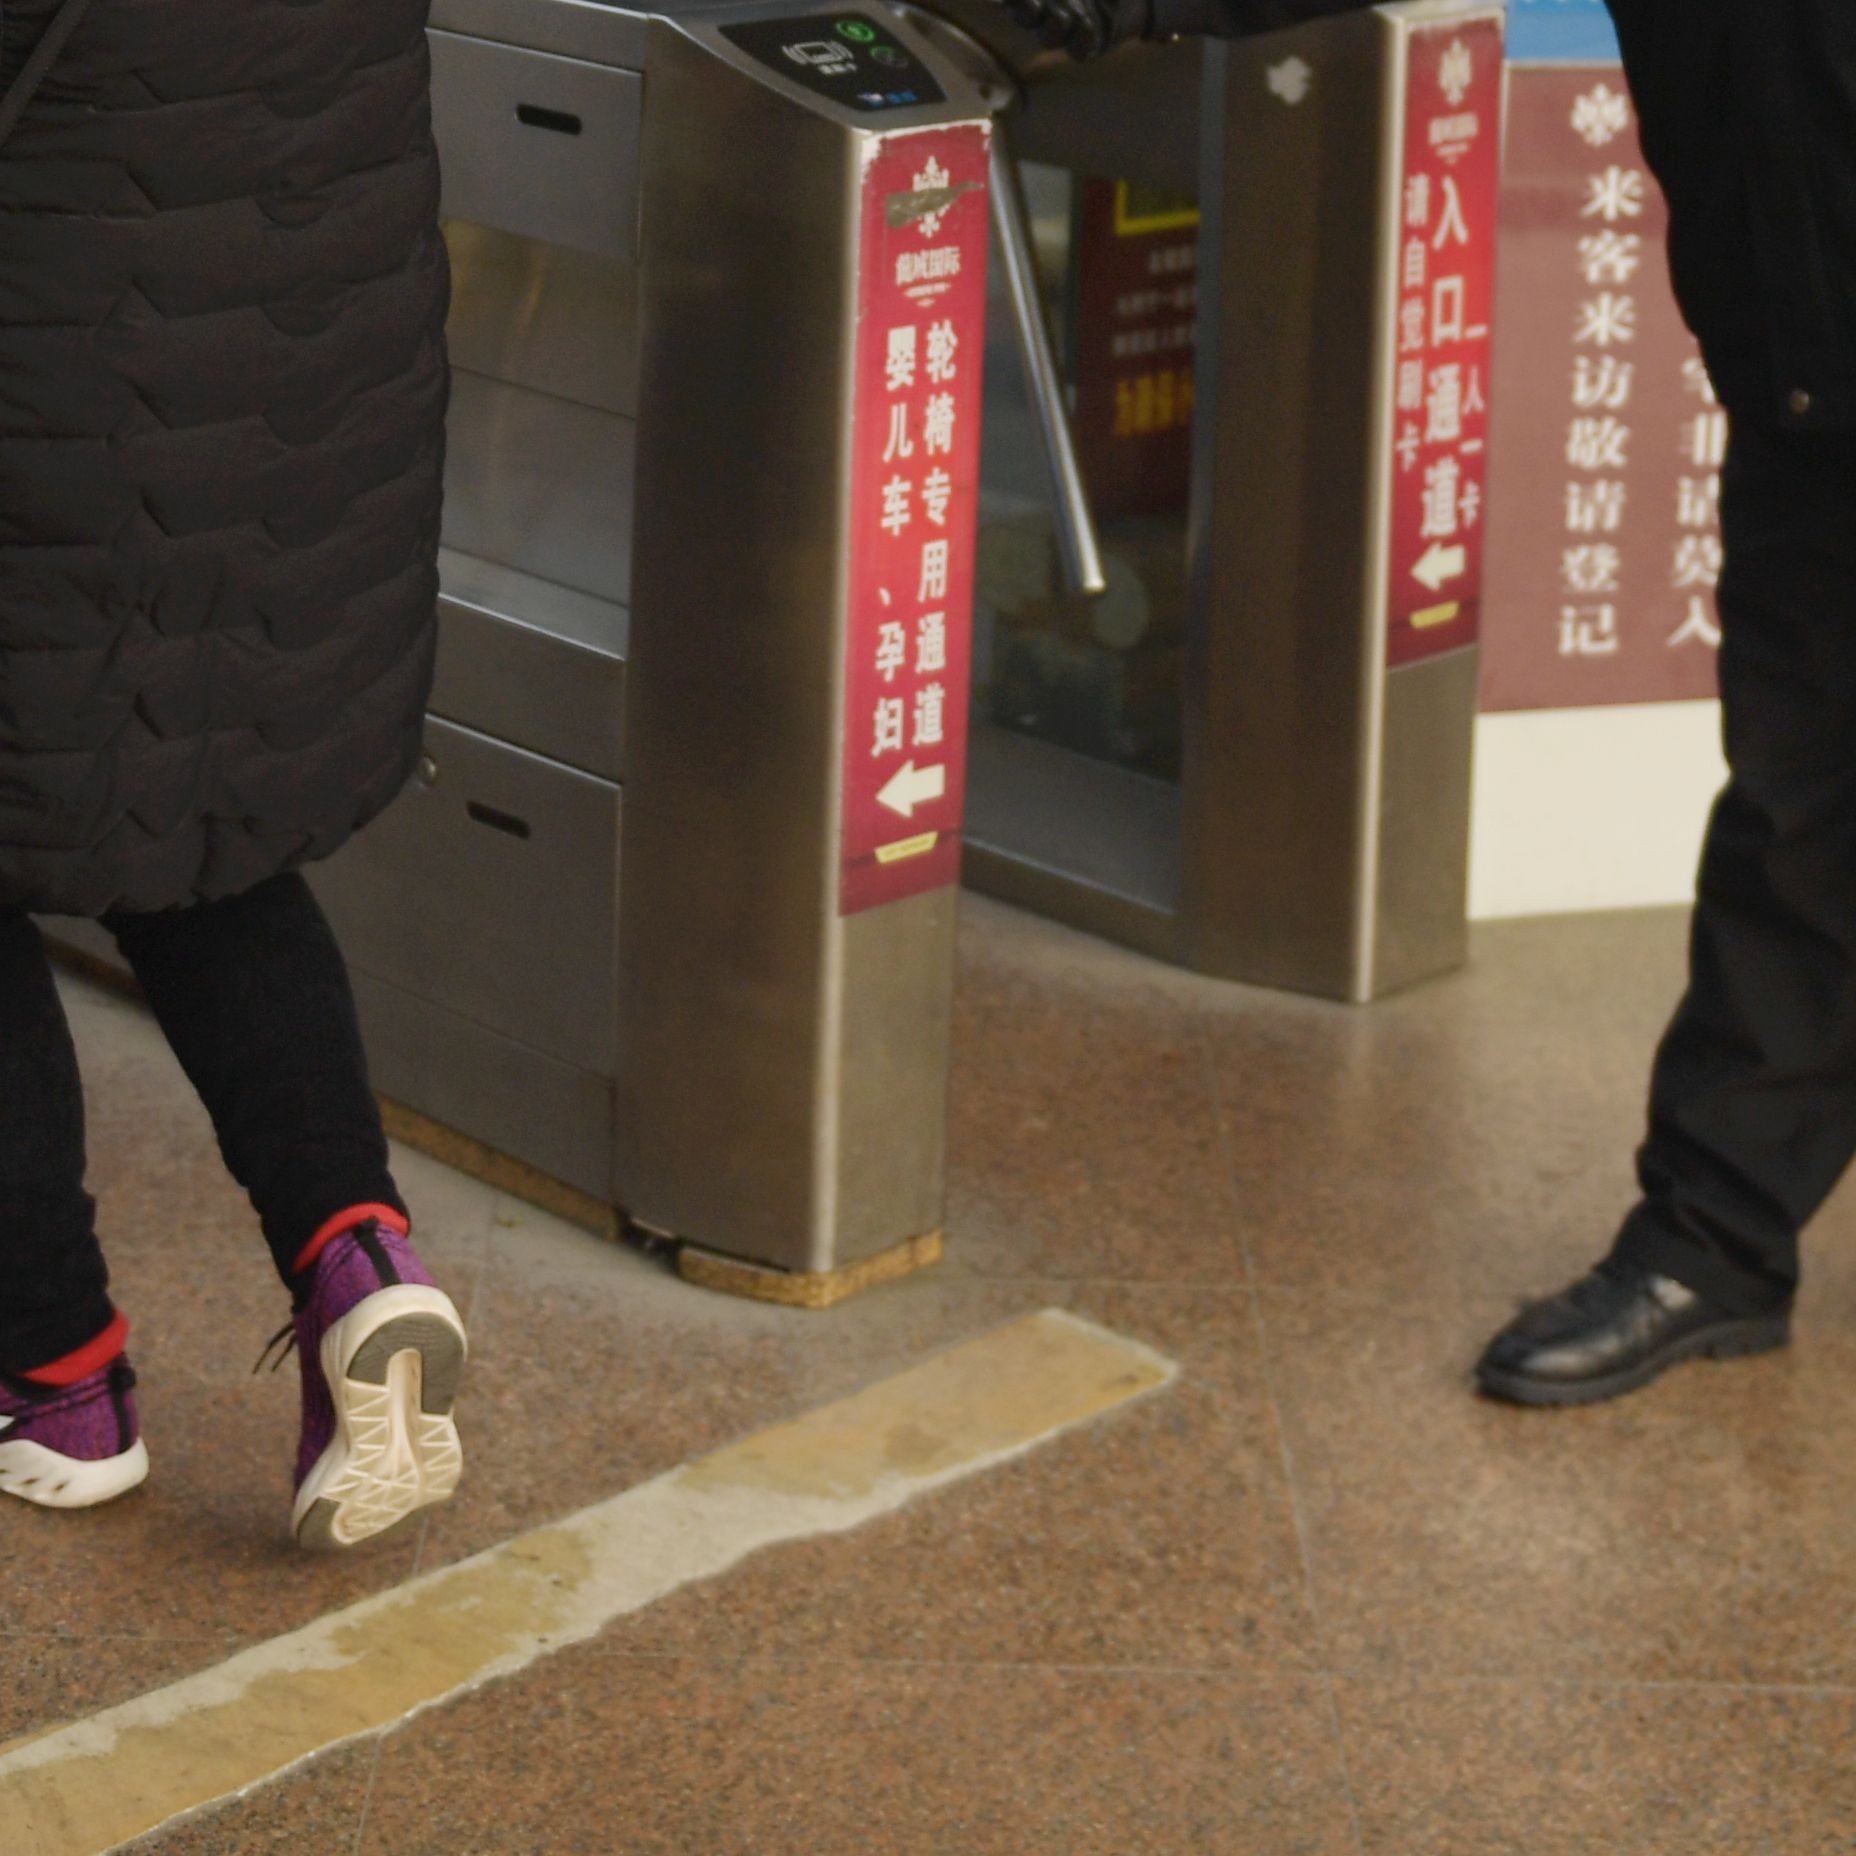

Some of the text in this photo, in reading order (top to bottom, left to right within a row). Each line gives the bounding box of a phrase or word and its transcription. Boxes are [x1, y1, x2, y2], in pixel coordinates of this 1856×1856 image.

[871, 325, 916, 759] 婴儿车、孕妇
[912, 319, 958, 747] 轮椅专用通道
[1420, 175, 1469, 539] 入口通道
[1458, 323, 1488, 529] 一人一卡
[1557, 164, 1643, 656] 来客来访敬请登记
